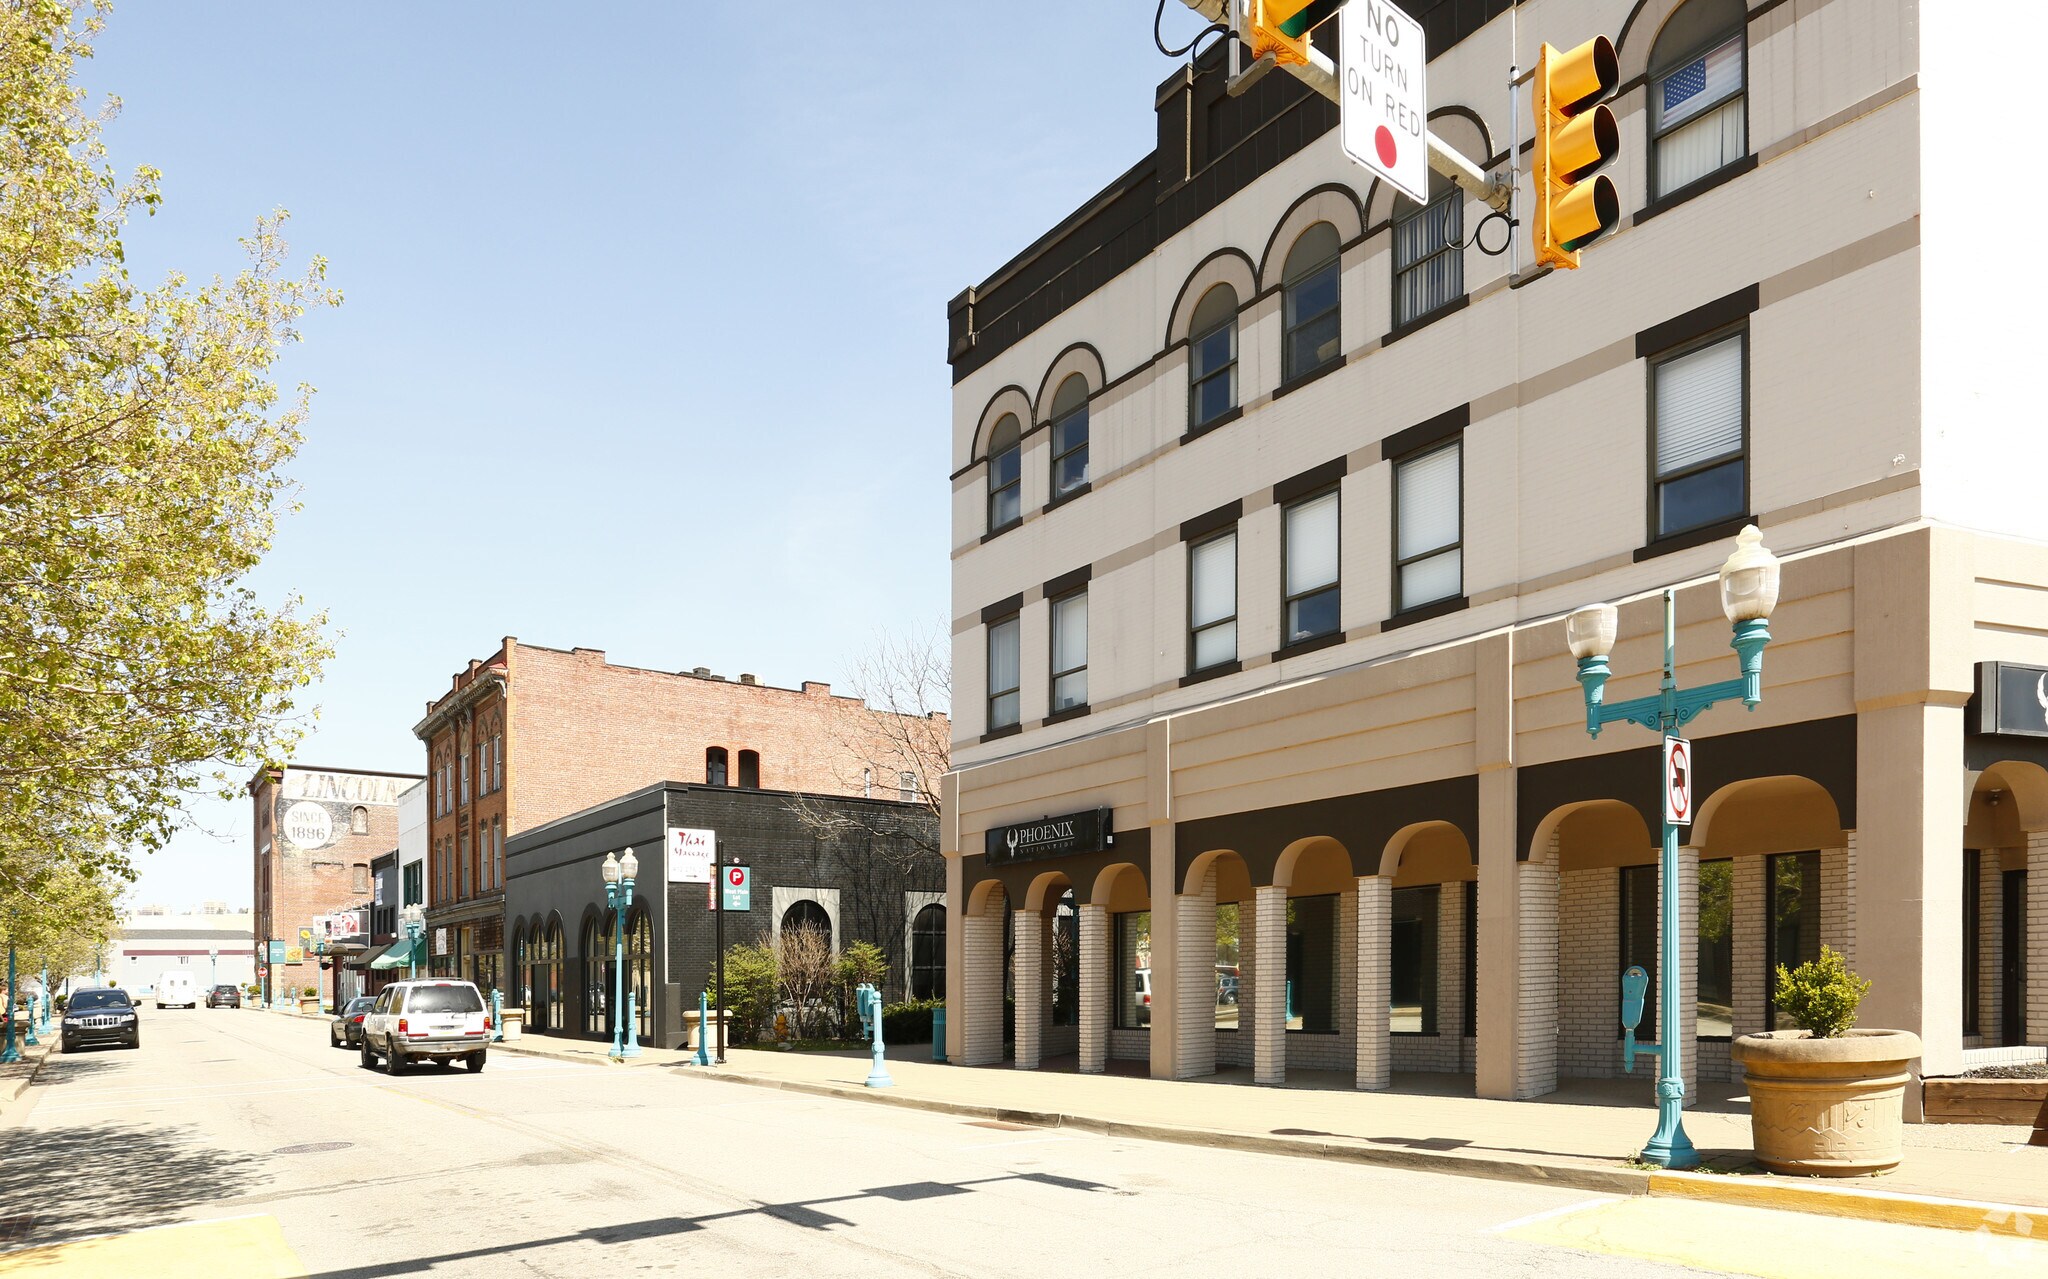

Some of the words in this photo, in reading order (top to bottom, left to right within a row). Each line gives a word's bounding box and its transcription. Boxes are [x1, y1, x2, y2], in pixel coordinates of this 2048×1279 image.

[1367, 0, 1399, 47] NO
[1360, 34, 1407, 93] TURN
[1349, 67, 1372, 106] ON
[1386, 93, 1420, 137] RED
[291, 810, 324, 823] SINCE
[678, 831, 705, 847] Thai
[1020, 821, 1074, 844] PHOENIX
[732, 871, 742, 882] P
